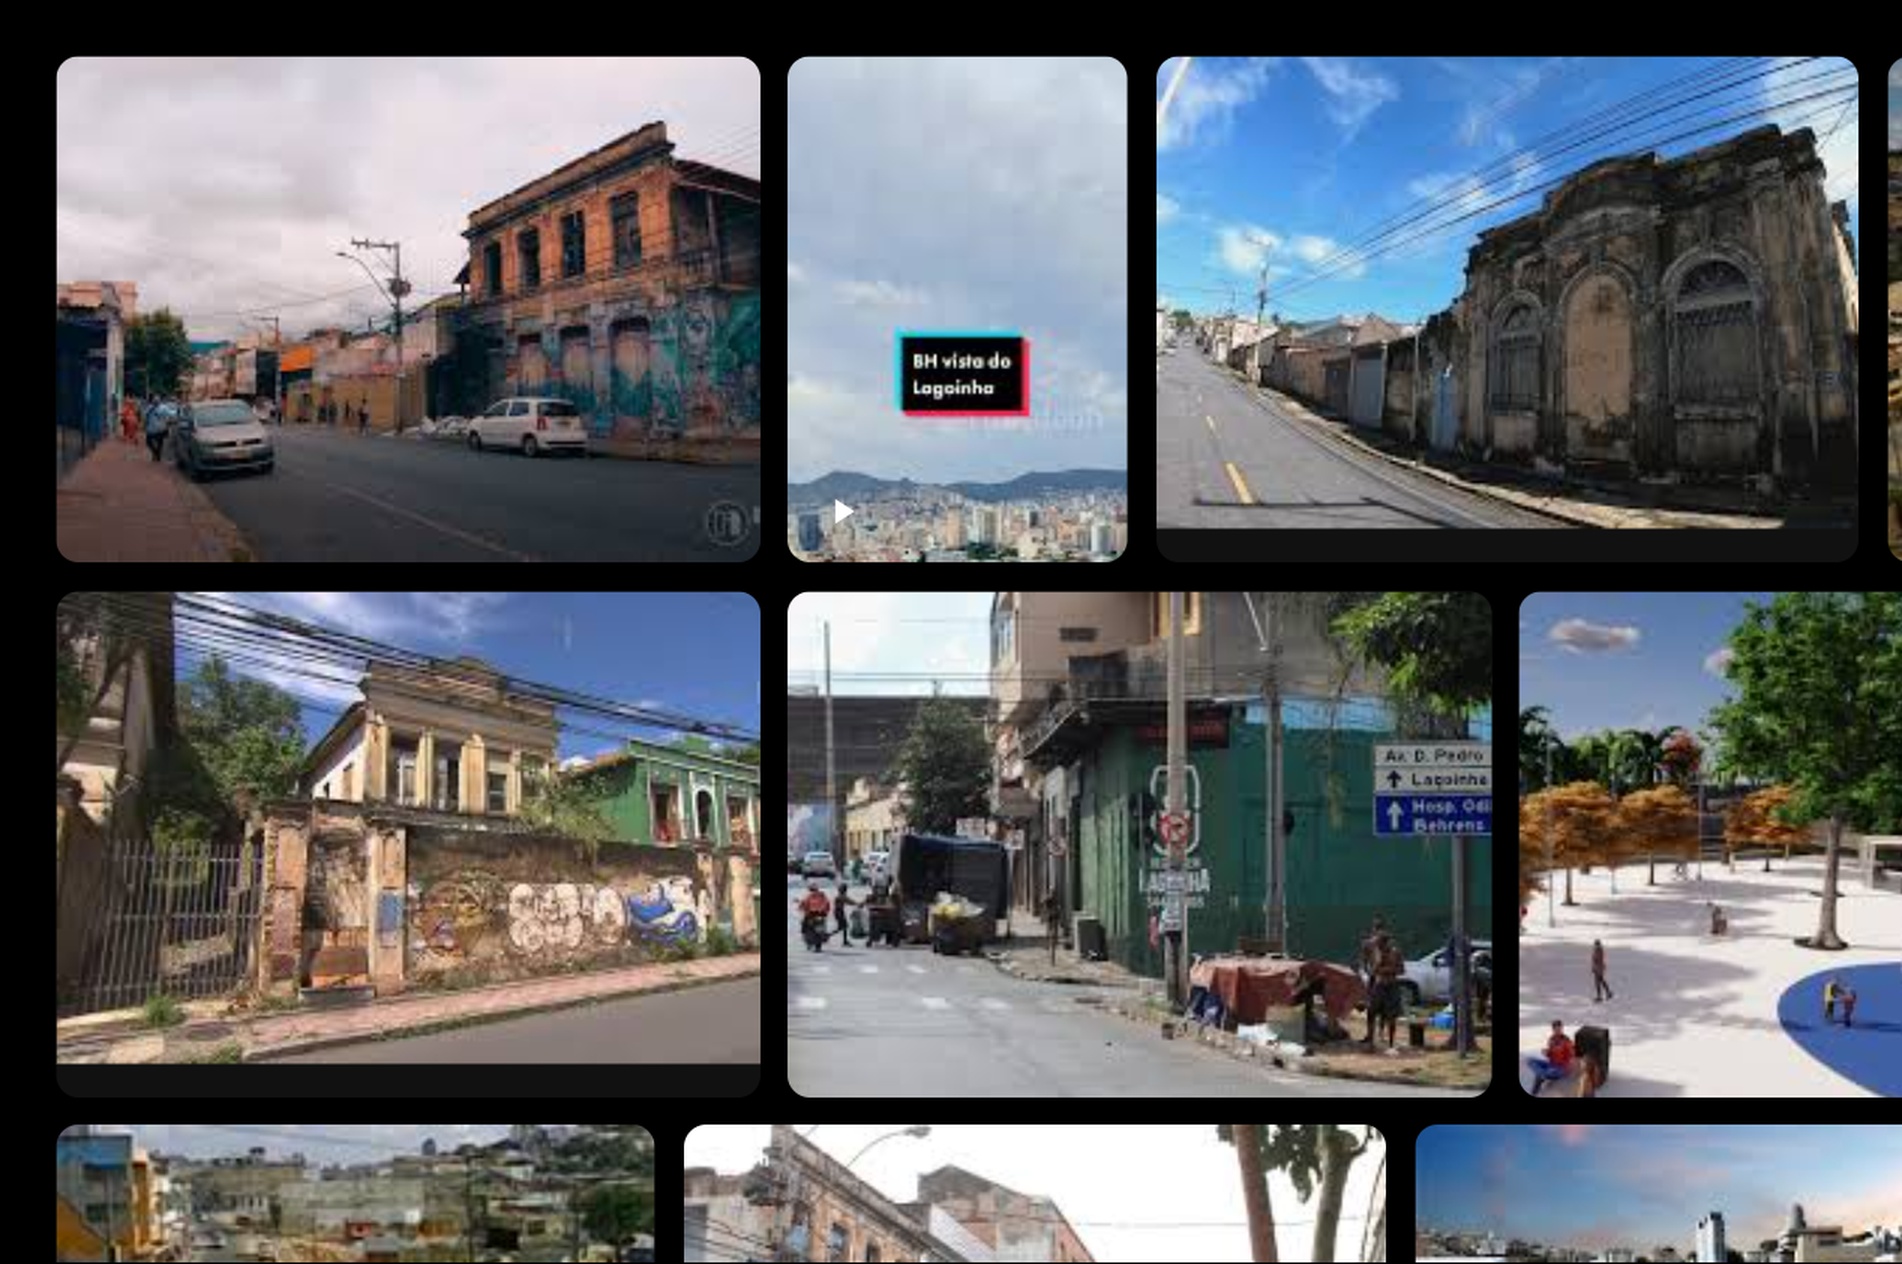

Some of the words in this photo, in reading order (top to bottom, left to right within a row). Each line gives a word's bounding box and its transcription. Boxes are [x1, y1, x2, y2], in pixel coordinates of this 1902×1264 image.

[1435, 748, 1484, 762] Pedro
[1411, 773, 1488, 791] Lagoinha
[1414, 818, 1484, 832] Behrens
